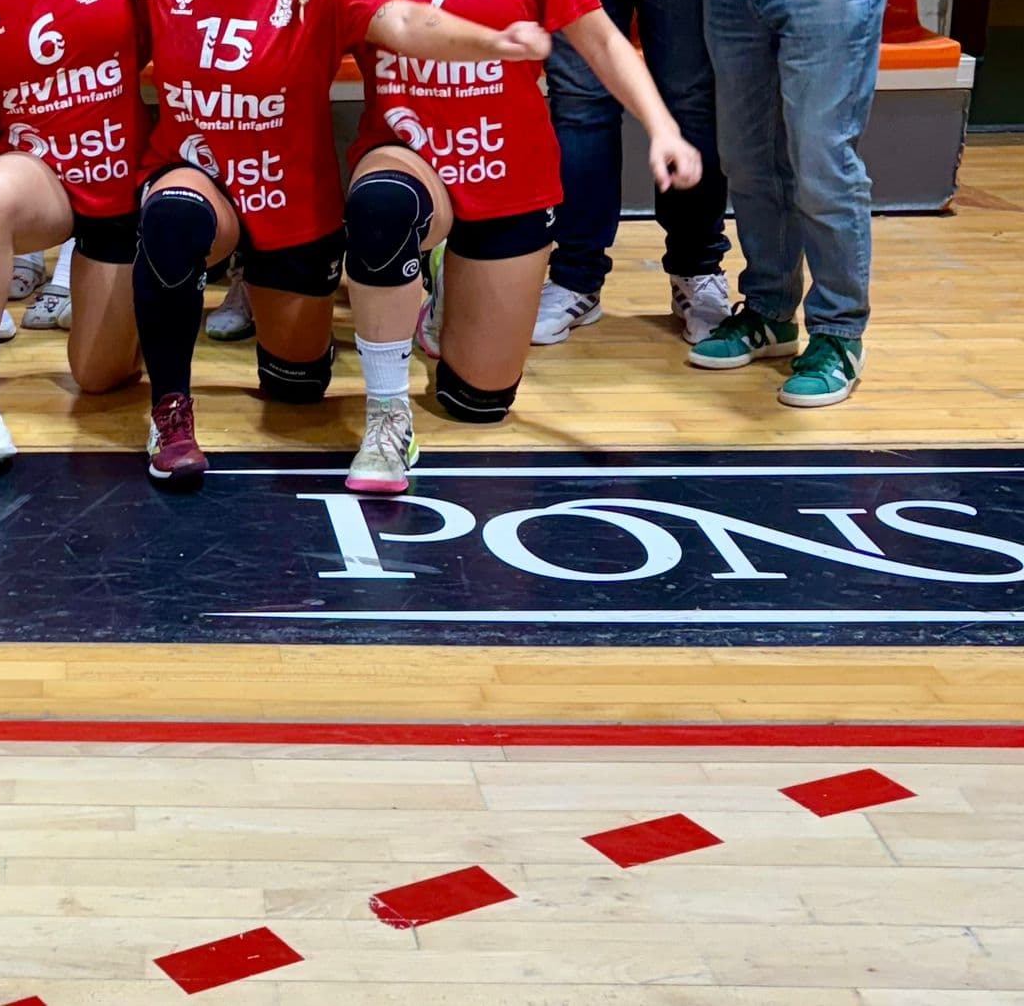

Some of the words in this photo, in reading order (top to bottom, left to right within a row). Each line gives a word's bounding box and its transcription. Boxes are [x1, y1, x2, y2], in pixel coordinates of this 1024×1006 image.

[28, 12, 66, 66] 6
[196, 16, 258, 72] 15
[28, 96, 73, 115] dental
[77, 85, 124, 105] infantil
[455, 83, 504, 98] infantil
[238, 117, 284, 132] infantil
[295, 492, 1024, 585] PONS
